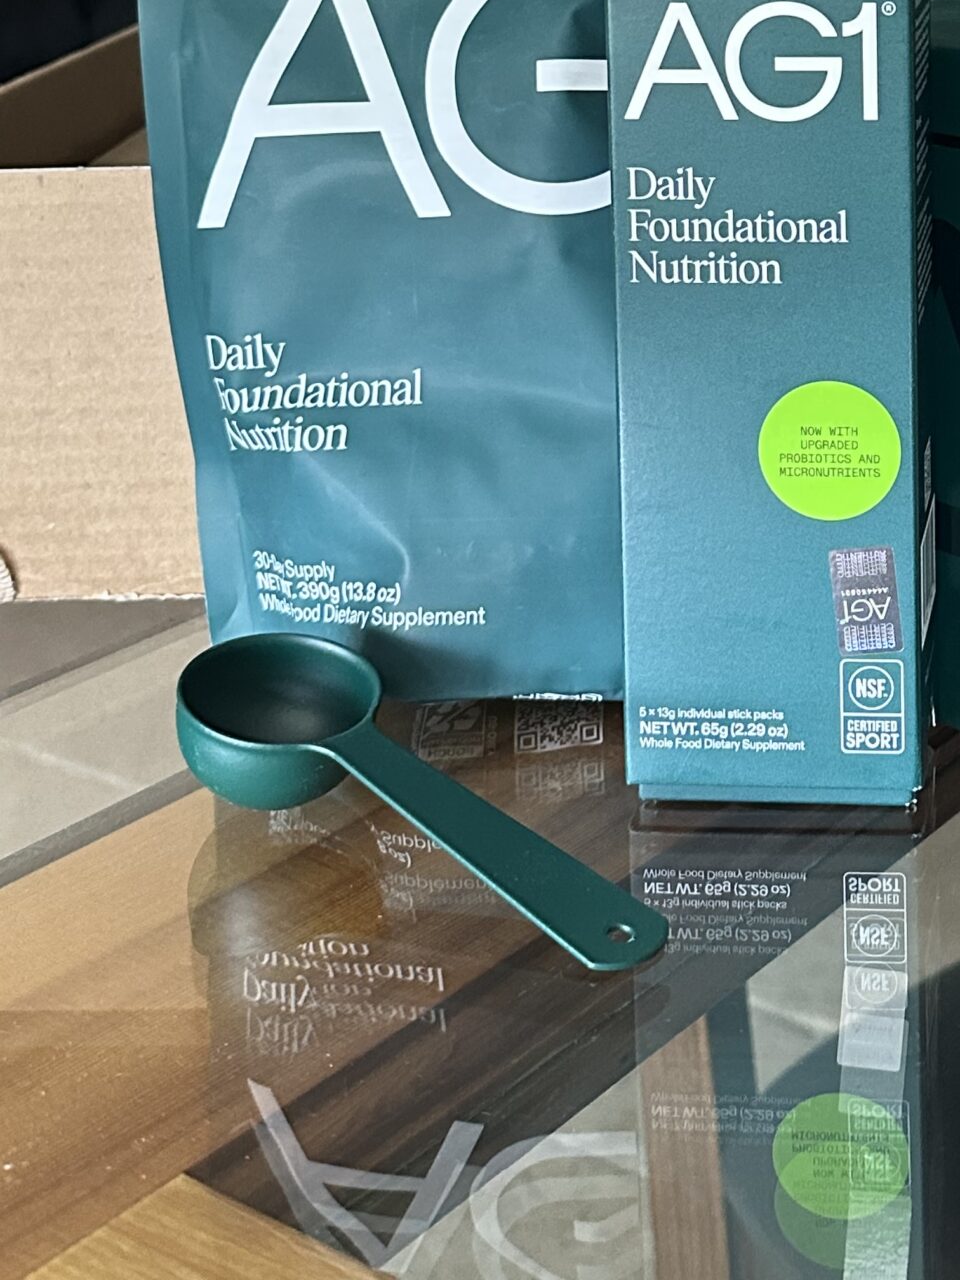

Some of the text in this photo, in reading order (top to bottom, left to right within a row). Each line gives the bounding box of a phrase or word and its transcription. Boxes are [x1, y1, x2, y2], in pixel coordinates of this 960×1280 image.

[626, 166, 716, 210] Daily
[627, 208, 849, 243] Foundational
[627, 250, 784, 285] Nutrition
[204, 332, 286, 377] Daily
[213, 368, 423, 414] Foundational
[223, 416, 348, 452] Nutrition
[800, 426, 859, 436] NOW WITH
[800, 439, 859, 450] UPGRADED
[778, 453, 880, 464] PROBIOTICS AND
[778, 466, 881, 478] MICRONUTRIENTS
[284, 558, 336, 582] Supply
[297, 581, 341, 605] 390g
[341, 580, 376, 603] (13.8
[376, 582, 401, 607] oz)
[322, 603, 370, 630] Dietary
[370, 606, 486, 631] Supplement
[638, 706, 647, 718] 5
[656, 707, 676, 721] 13g
[677, 708, 726, 720] individual
[727, 708, 753, 720] stick
[753, 708, 784, 722] packs
[639, 720, 789, 739] NET WT. 65g (2.29 oz)
[847, 719, 898, 732] CERTIFIED
[638, 737, 806, 752] Whole Food Dietary Supplement
[845, 732, 900, 749] SPORT
